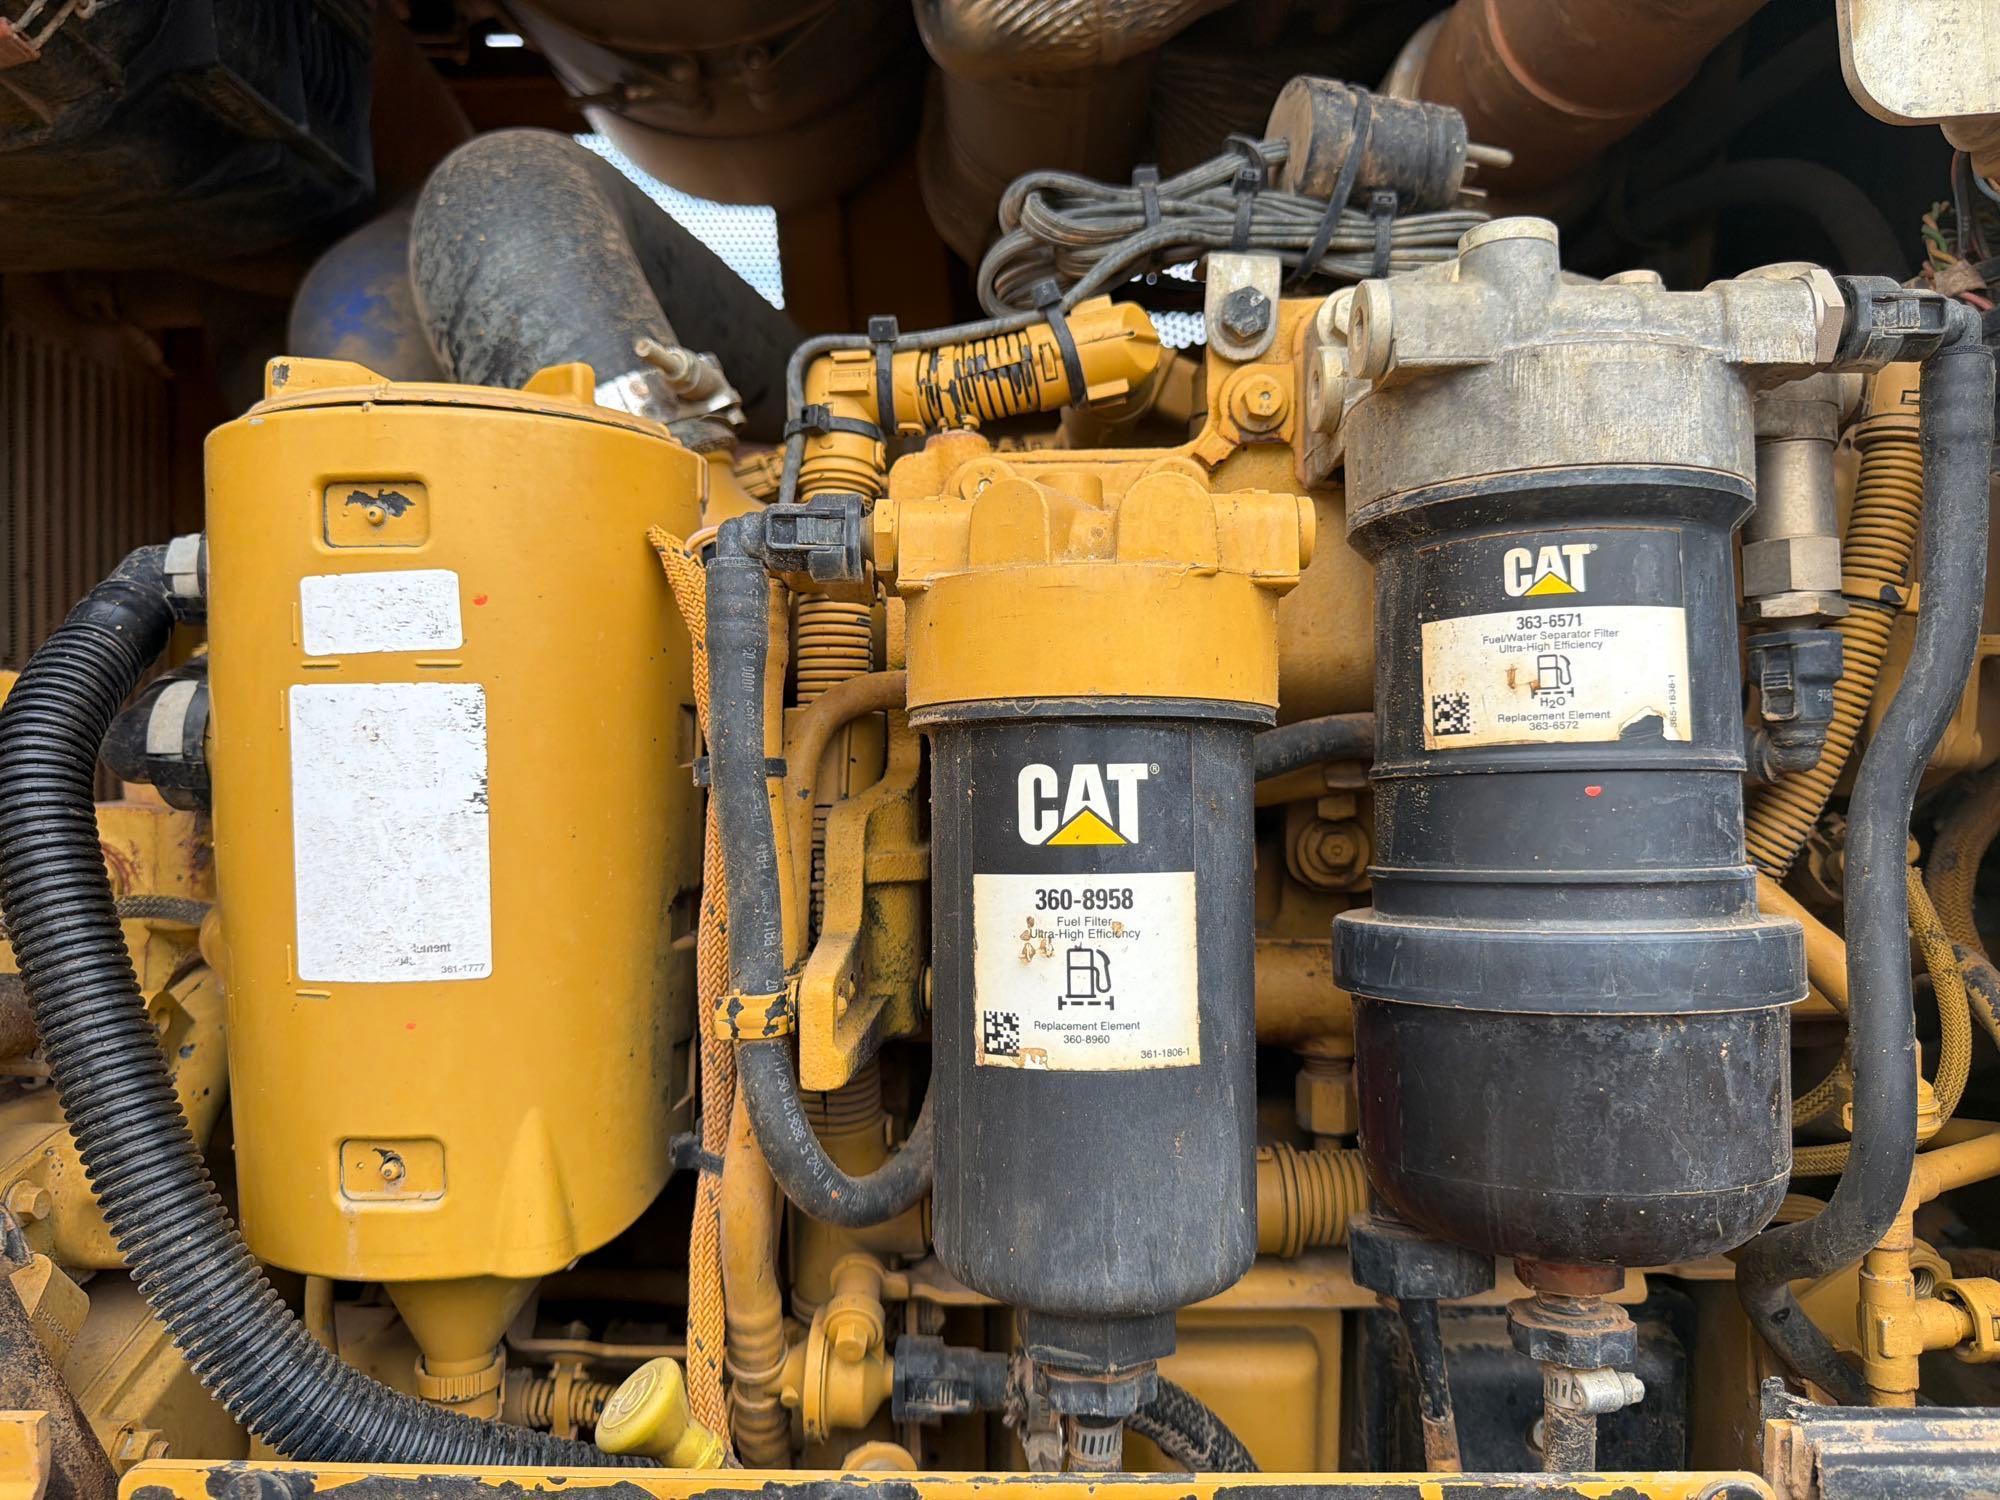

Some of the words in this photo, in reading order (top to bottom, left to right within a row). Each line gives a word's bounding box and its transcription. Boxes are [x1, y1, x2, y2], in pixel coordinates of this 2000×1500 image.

[1516, 613, 1583, 630] 363-6571
[1482, 633, 1537, 645] Fuel/Water
[1539, 630, 1591, 642] Separator
[1593, 629, 1619, 639] Filter
[1499, 641, 1550, 653] Ultra-High
[1553, 639, 1603, 651] Efficiency
[1540, 696, 1566, 709] H2O
[1497, 711, 1565, 724] Replacement
[1568, 710, 1611, 720] Element
[1529, 720, 1579, 731] 363-6572
[1035, 888, 1134, 911] 360-8958
[1057, 916, 1081, 927] Fuel
[1084, 916, 1113, 927] Filter
[1030, 928, 1084, 941] Ultra-High
[441, 963, 486, 974] 361-1777
[1034, 1021, 1098, 1032] Replacement
[1100, 1021, 1141, 1031] Element
[1063, 1035, 1110, 1044] 360-8960
[1140, 1048, 1190, 1059] 361-1806-1
